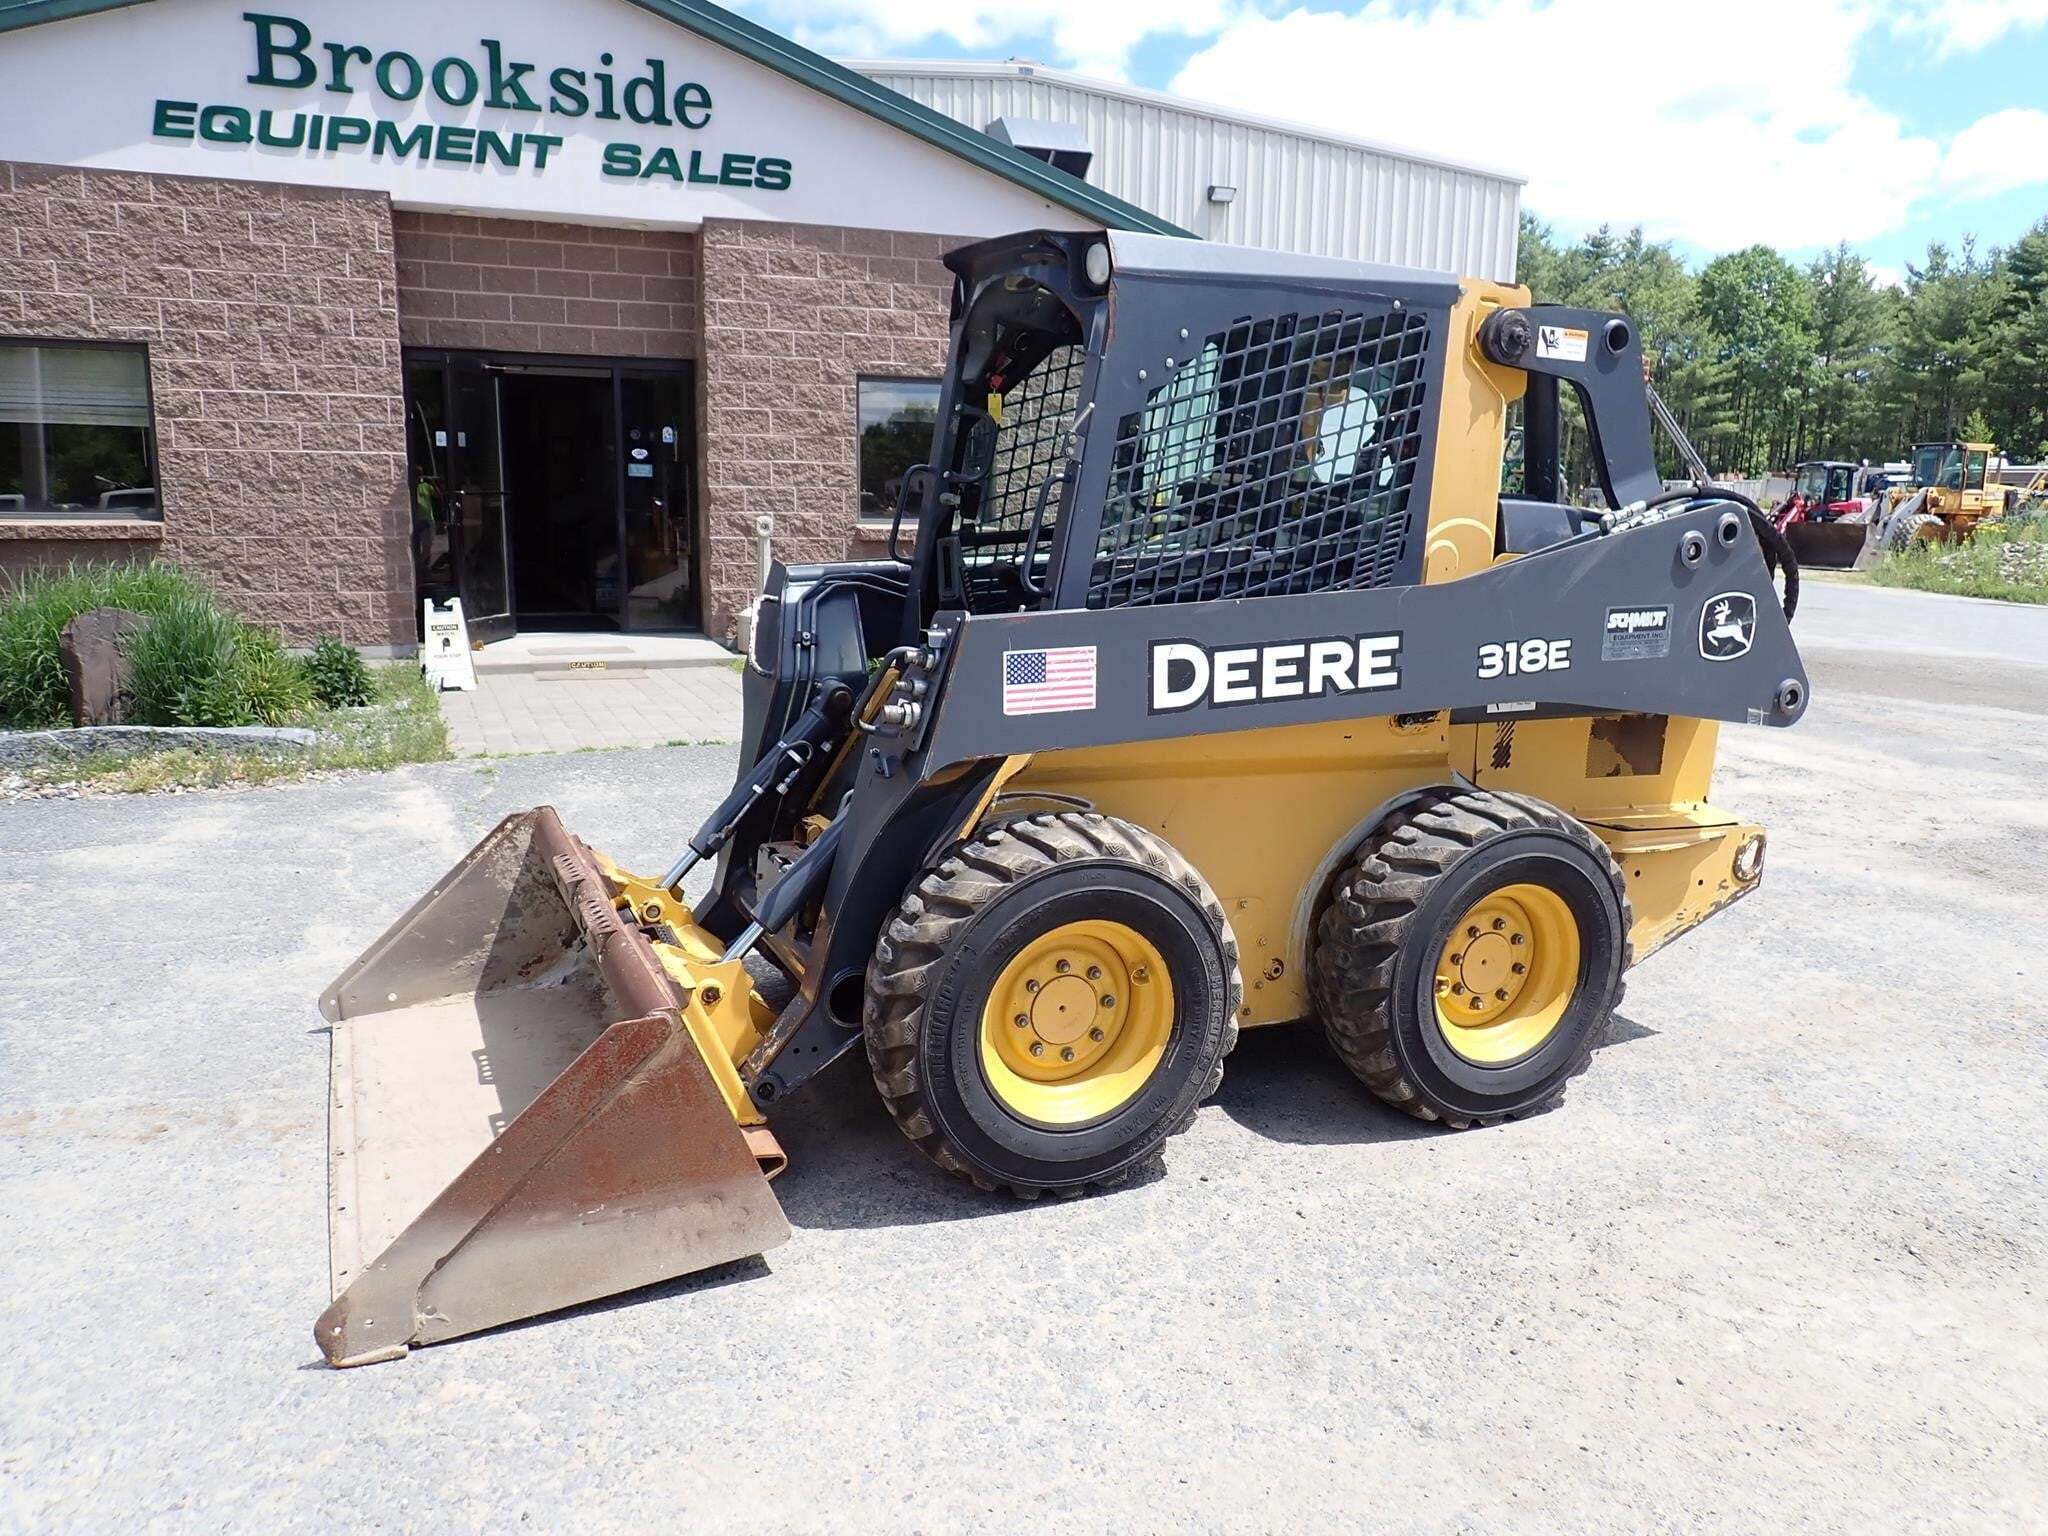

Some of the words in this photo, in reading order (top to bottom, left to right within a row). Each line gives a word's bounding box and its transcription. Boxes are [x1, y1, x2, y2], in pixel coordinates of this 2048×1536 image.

[244, 12, 713, 129] Brookside
[153, 99, 564, 169] EQUIPMENT
[602, 142, 793, 191] SALES
[1151, 635, 1401, 710] DEERE
[1477, 638, 1572, 679] 318E
